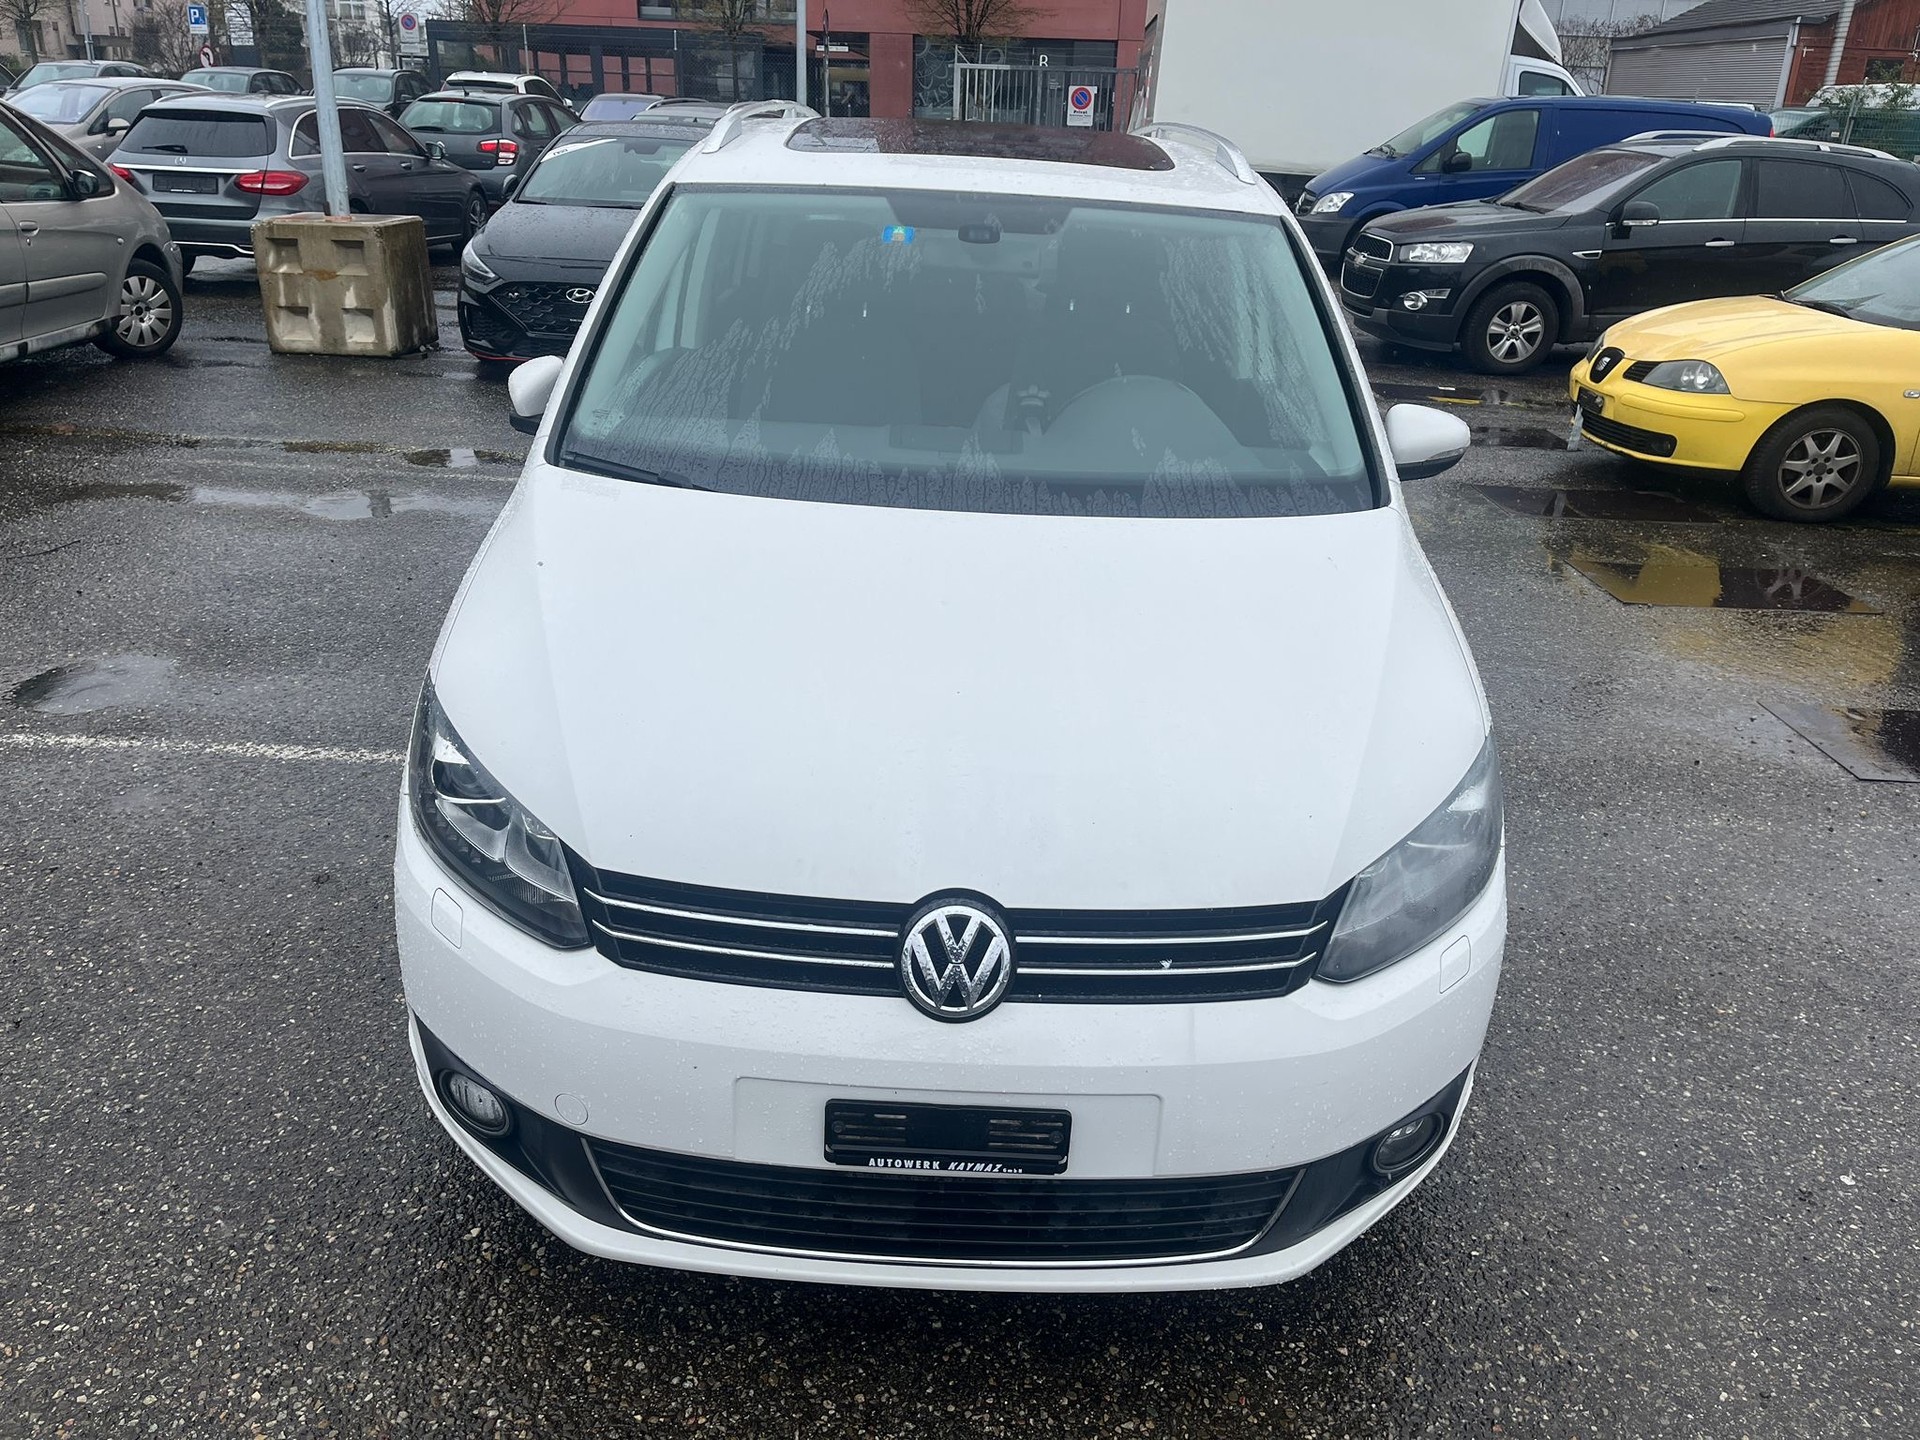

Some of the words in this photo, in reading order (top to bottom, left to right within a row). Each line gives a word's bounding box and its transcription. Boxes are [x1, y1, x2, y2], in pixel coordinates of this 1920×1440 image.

[190, 9, 199, 23] P
[902, 905, 1011, 1017] VW
[868, 1157, 940, 1170] AUTOWERK
[947, 1161, 1003, 1173] KAYMAZ
